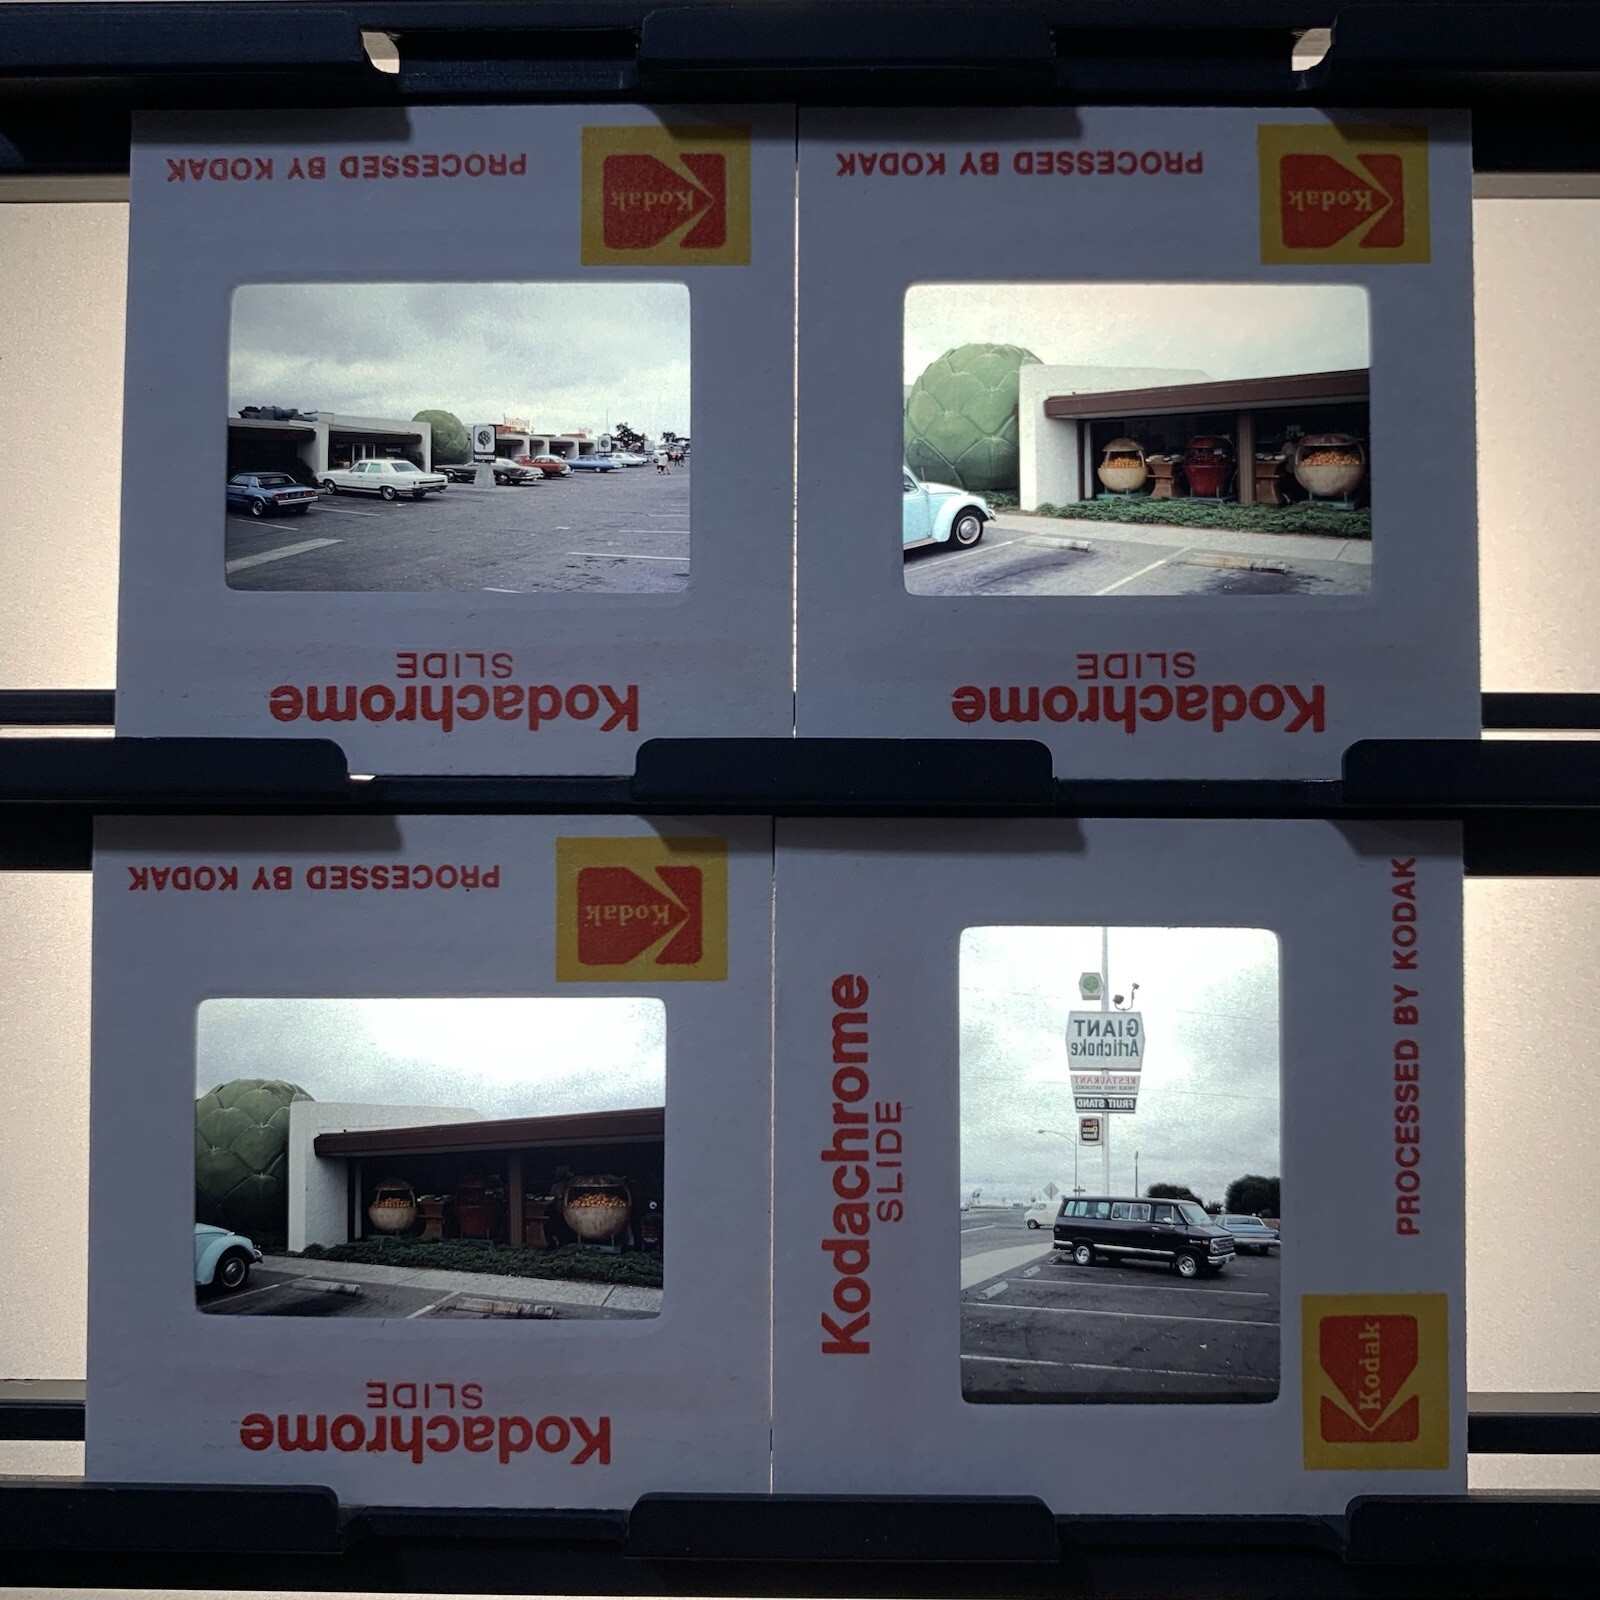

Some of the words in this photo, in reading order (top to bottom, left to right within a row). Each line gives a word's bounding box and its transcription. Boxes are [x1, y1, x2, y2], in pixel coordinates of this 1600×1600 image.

[166, 157, 273, 182] KODAK
[288, 156, 325, 180] BY
[340, 154, 526, 178] PROCESSED
[836, 151, 946, 176] KODAK
[960, 150, 999, 174] BY
[1013, 150, 1202, 174] PROCESSED
[609, 189, 694, 212] Kodak
[1288, 190, 1373, 212] Kodak
[396, 652, 512, 679] SLIDE
[1077, 651, 1195, 679] SLIDE
[269, 683, 639, 732] Kodachrome
[951, 683, 1325, 733] Kodachrome
[128, 865, 237, 891] KODAK
[251, 865, 292, 890] BY
[306, 864, 499, 890] PROCESSED
[584, 904, 670, 926] Kodak
[1391, 857, 1418, 970] KODAK
[1392, 983, 1419, 1025] BY
[1394, 1038, 1420, 1235] PROCESSED
[820, 973, 871, 1355] Kodachrome
[874, 1101, 904, 1222] SLIDE
[1358, 1322, 1381, 1410] Kodak
[366, 1381, 484, 1408] SLIDE
[240, 1411, 610, 1466] Kodachrome
